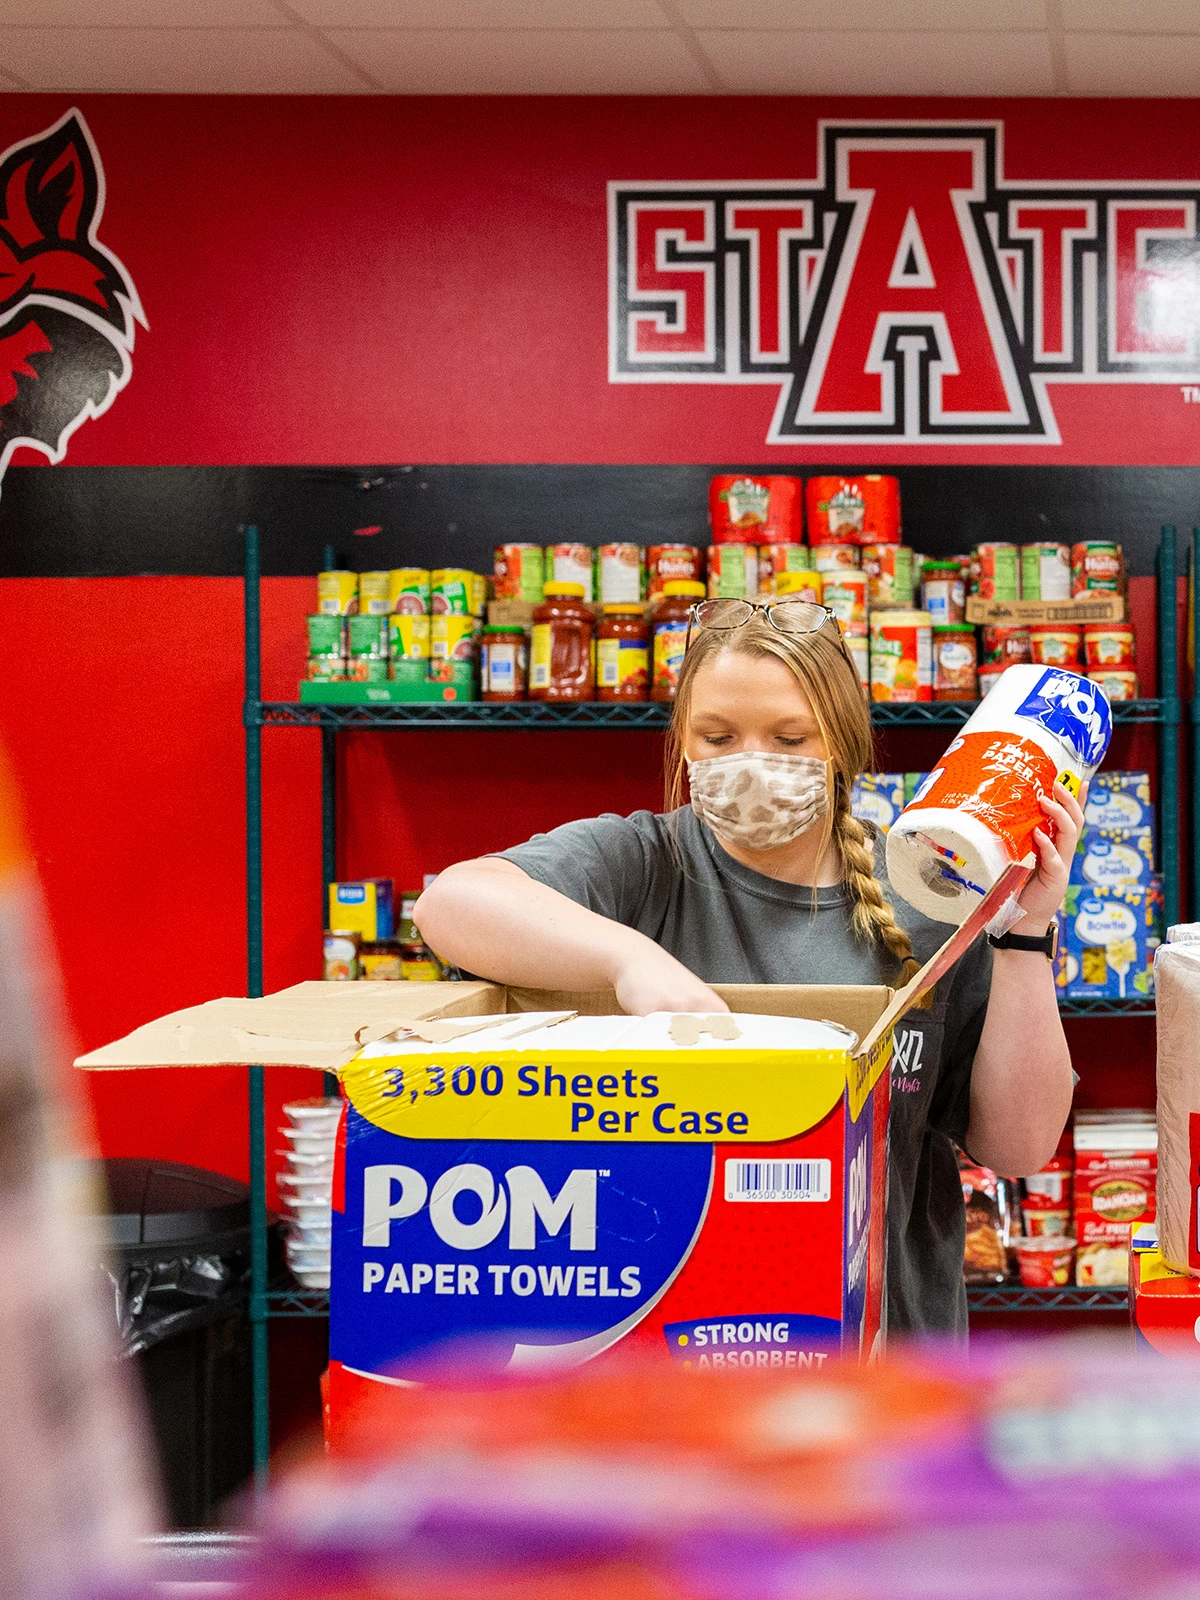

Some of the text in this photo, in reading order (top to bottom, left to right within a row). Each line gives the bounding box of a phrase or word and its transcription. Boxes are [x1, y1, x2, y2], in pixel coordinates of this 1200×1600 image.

[1037, 677, 1106, 760] POM
[989, 741, 1001, 750] 2
[981, 751, 1034, 781] PAPER
[1097, 813, 1130, 824] Shells
[1097, 864, 1131, 876] Shells
[382, 1065, 660, 1104] 3,300 Sheets
[571, 1102, 750, 1135] Per Case
[362, 1162, 598, 1251] POM
[746, 1191, 776, 1199] 36500
[781, 1191, 811, 1199] 30504
[363, 1263, 642, 1298] PAPER TOWELS
[693, 1322, 789, 1346] STRONG
[699, 1350, 828, 1369] ABSORBENT
